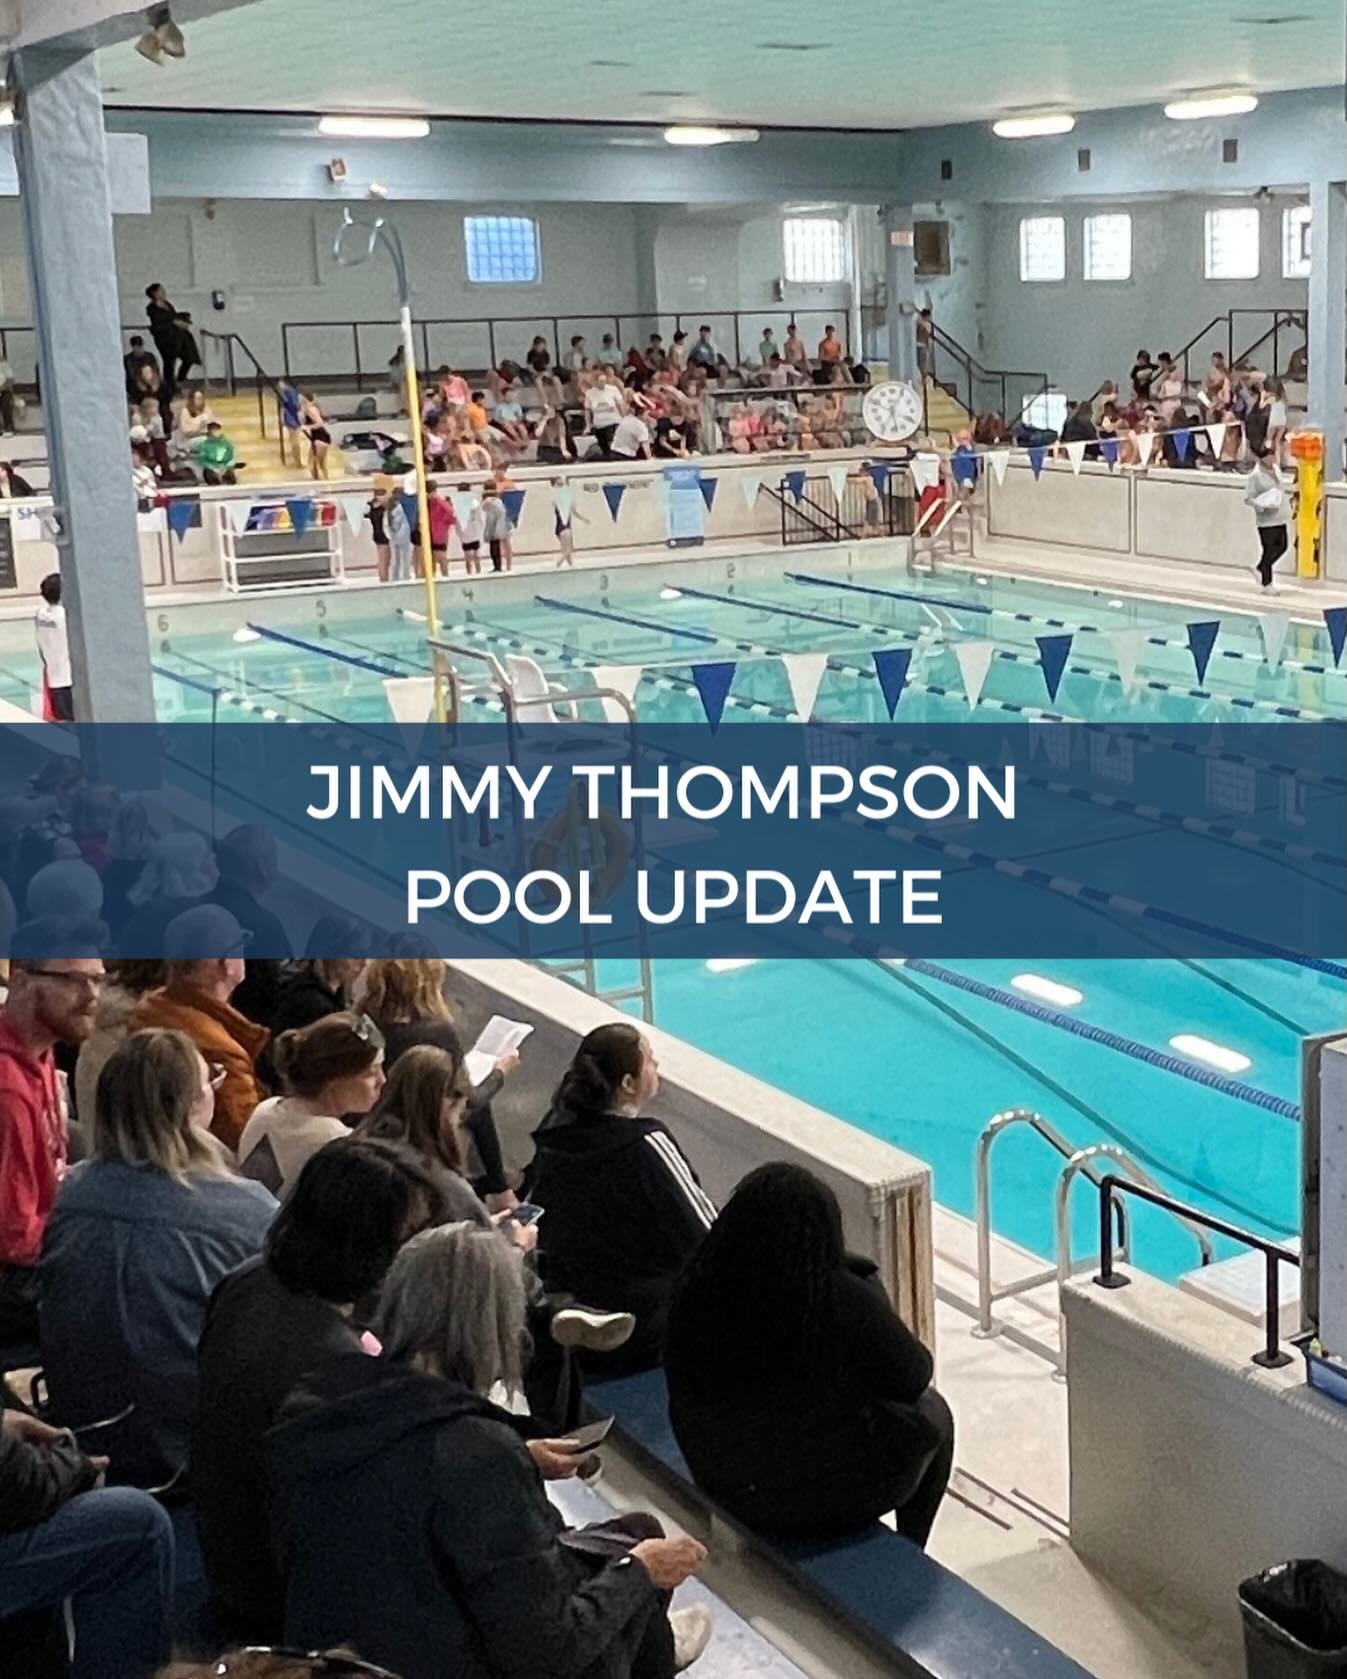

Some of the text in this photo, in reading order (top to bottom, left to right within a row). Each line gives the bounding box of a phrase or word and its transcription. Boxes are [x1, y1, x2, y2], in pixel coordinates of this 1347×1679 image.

[727, 562, 736, 579] 2
[599, 575, 609, 591] 3
[461, 587, 474, 601] 4
[315, 599, 326, 617] 5
[157, 614, 169, 632] 6
